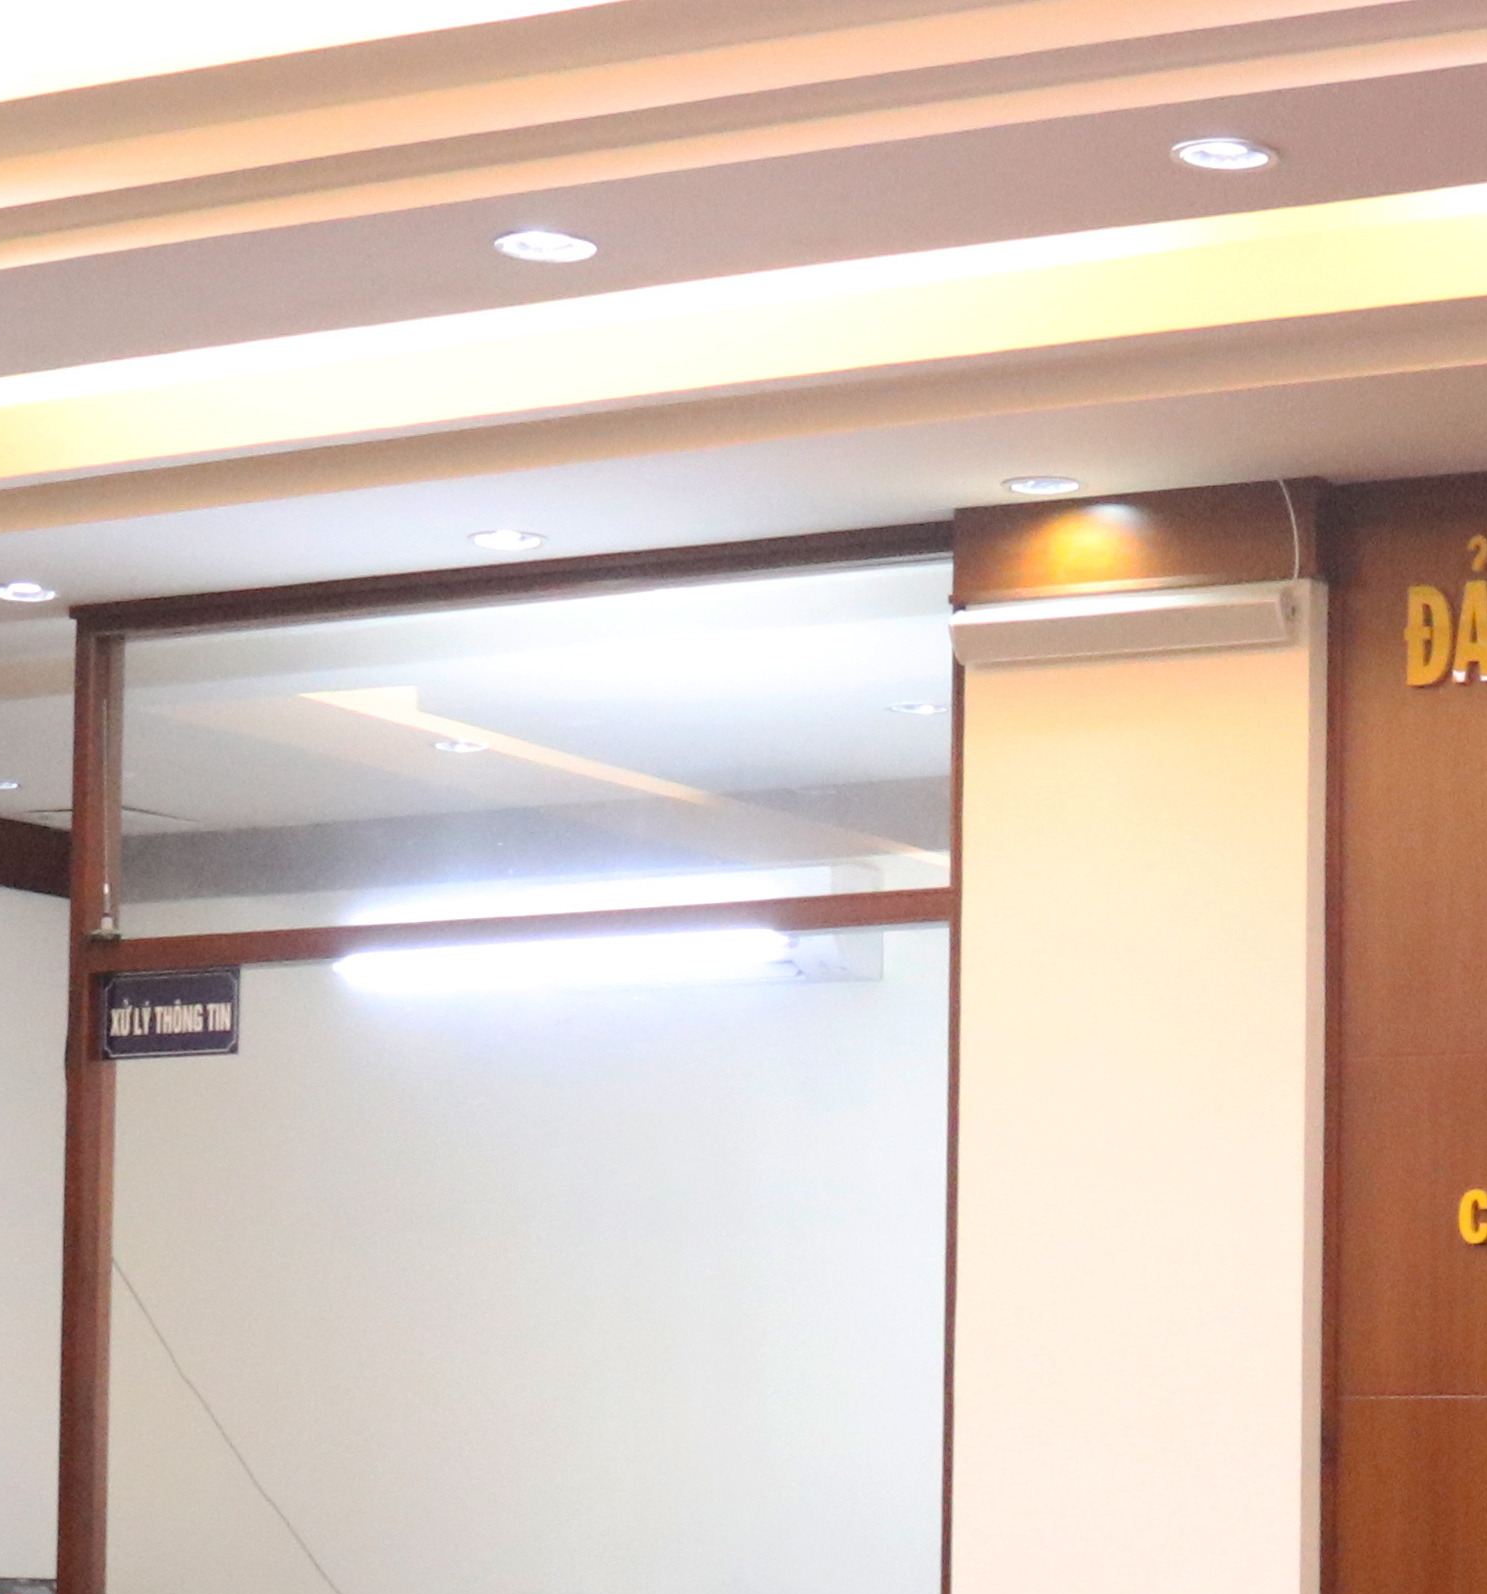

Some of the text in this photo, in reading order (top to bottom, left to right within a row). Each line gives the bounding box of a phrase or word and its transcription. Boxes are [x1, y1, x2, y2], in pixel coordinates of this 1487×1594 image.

[133, 1000, 152, 1036] LÝ
[154, 999, 204, 1034] THÔNG
[206, 1002, 232, 1032] TIN
